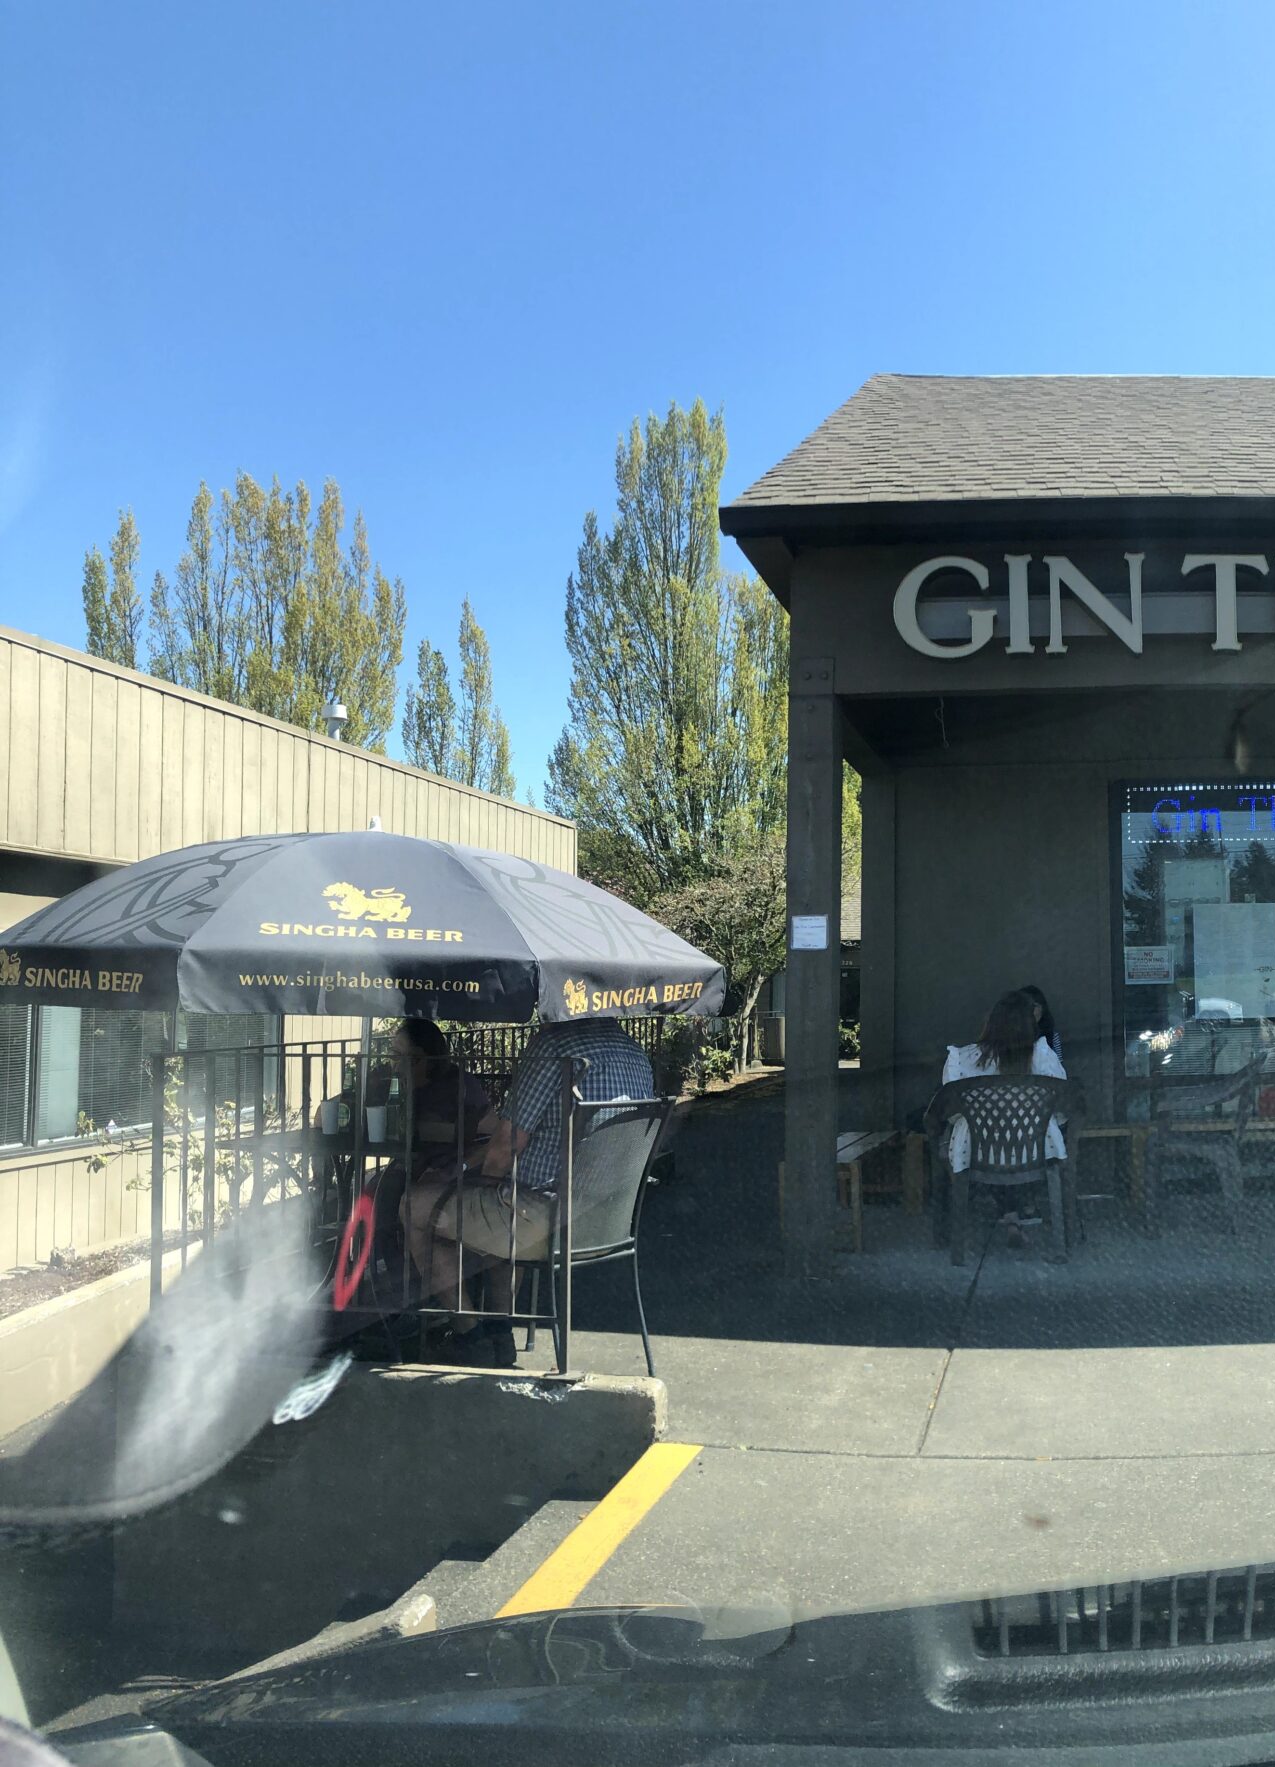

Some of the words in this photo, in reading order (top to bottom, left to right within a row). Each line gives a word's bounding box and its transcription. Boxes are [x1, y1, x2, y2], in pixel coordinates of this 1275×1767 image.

[893, 551, 1146, 659] GIN
[1152, 794, 1222, 833] Gin
[258, 922, 377, 938] SINGHA
[386, 927, 464, 942] BEER
[24, 967, 92, 990] SINGHA
[98, 970, 144, 993] BEER
[239, 971, 480, 993] www.singhabeerusa.com
[592, 985, 658, 1012] SINGHA
[663, 982, 703, 1003] BEER
